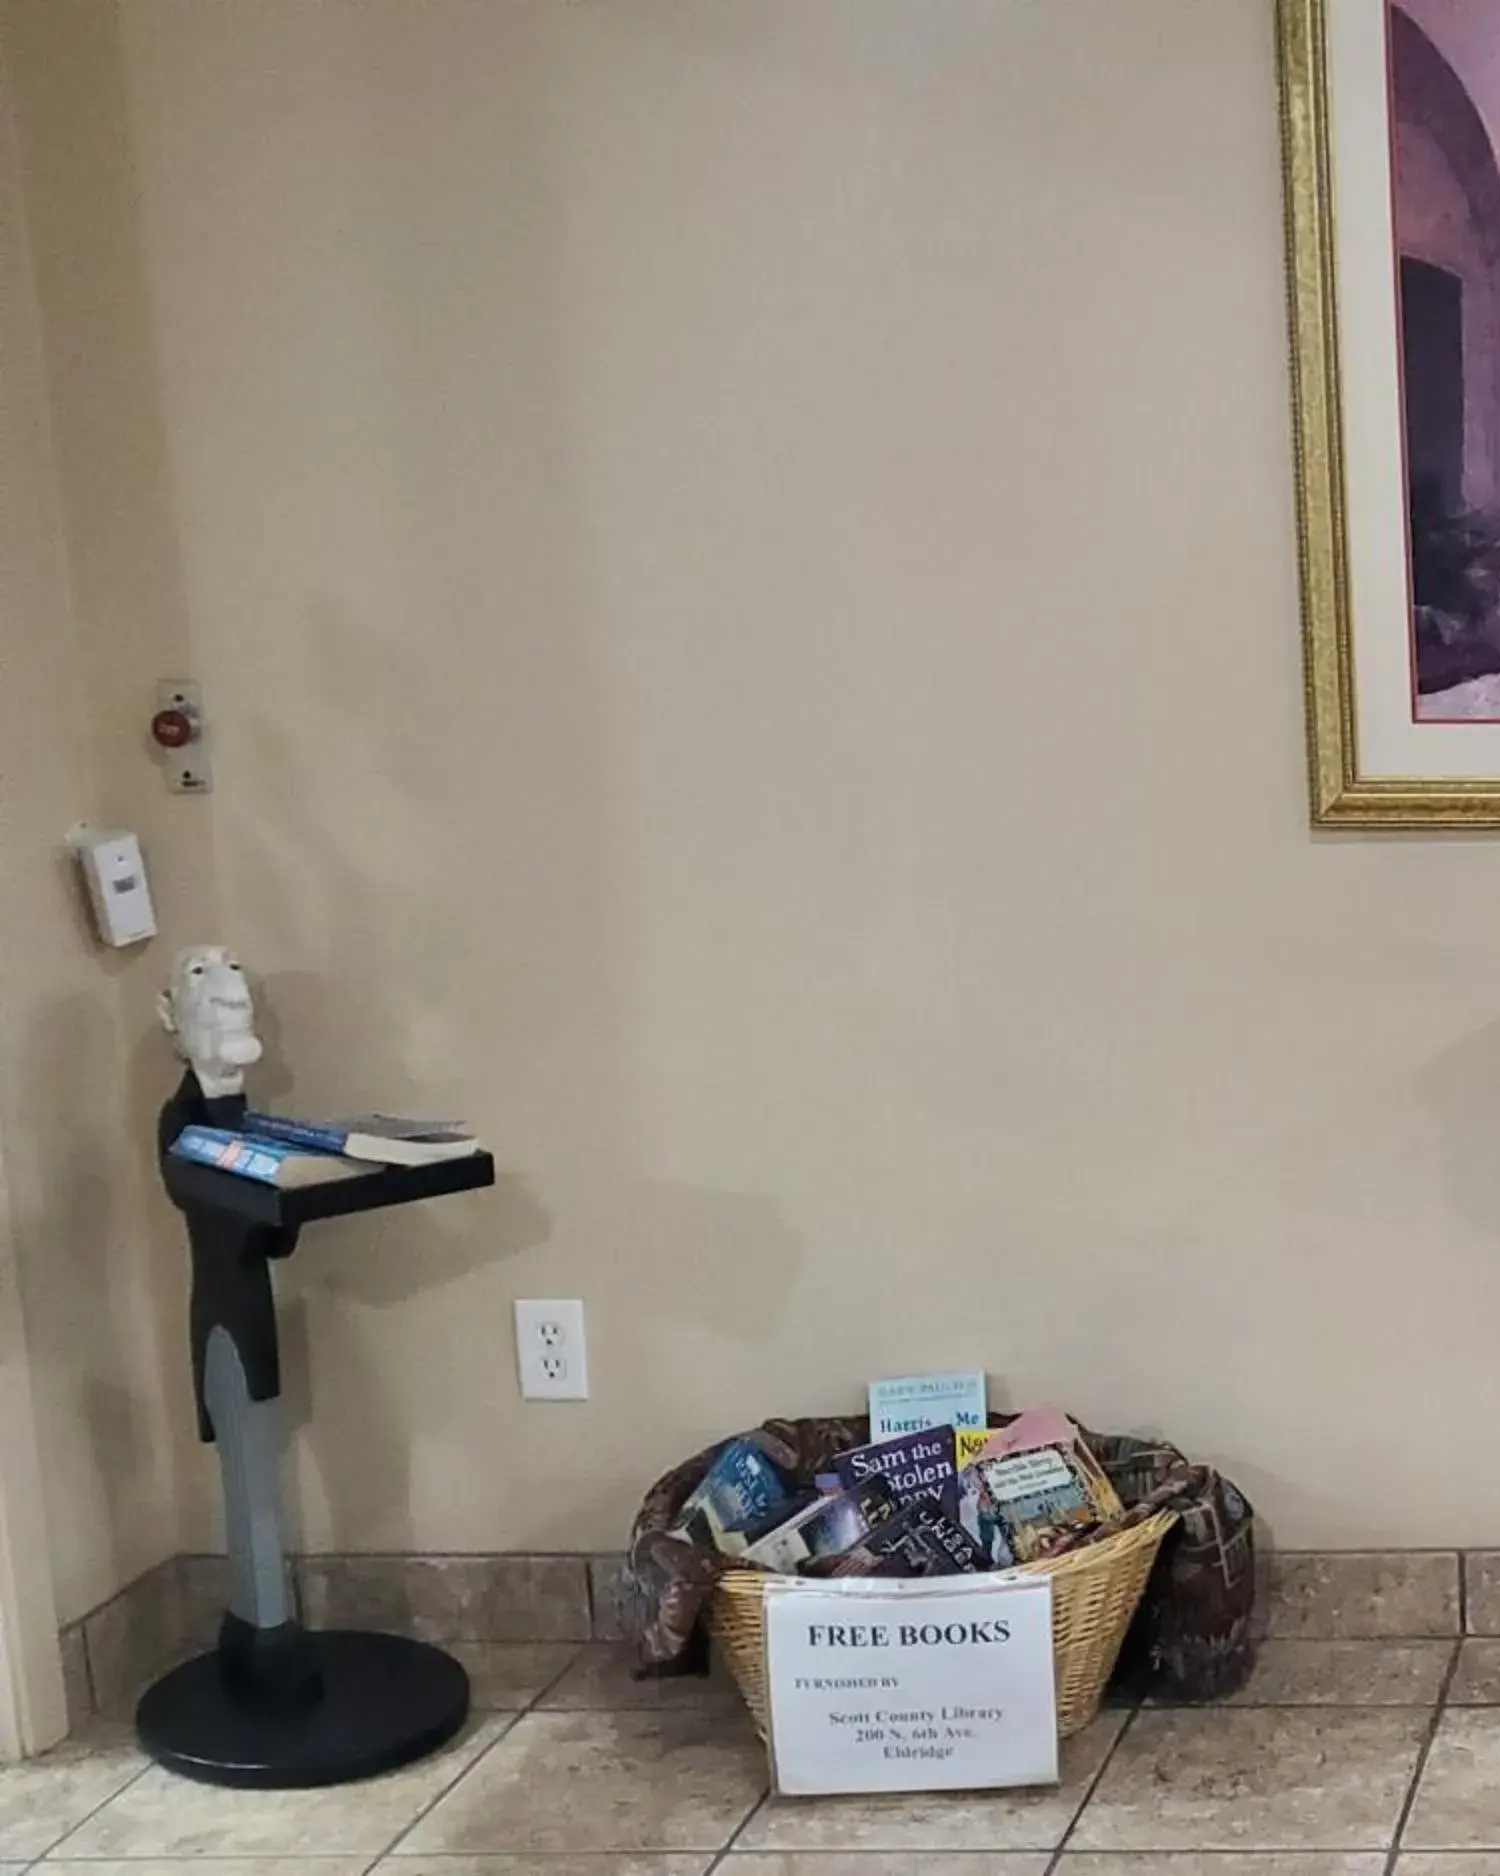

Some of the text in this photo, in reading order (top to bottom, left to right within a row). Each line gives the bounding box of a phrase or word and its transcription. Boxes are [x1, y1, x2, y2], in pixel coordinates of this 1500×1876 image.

[956, 1410, 980, 1427] Me
[850, 1441, 942, 1478] Sam the
[808, 1620, 1011, 1647] FREE BOOKS
[795, 1676, 899, 1690] FURNISHED BY
[829, 1706, 1003, 1726] Scott County Library
[855, 1729, 885, 1743] 200
[911, 1727, 938, 1741] 6th
[883, 1746, 955, 1760] Eldridge
